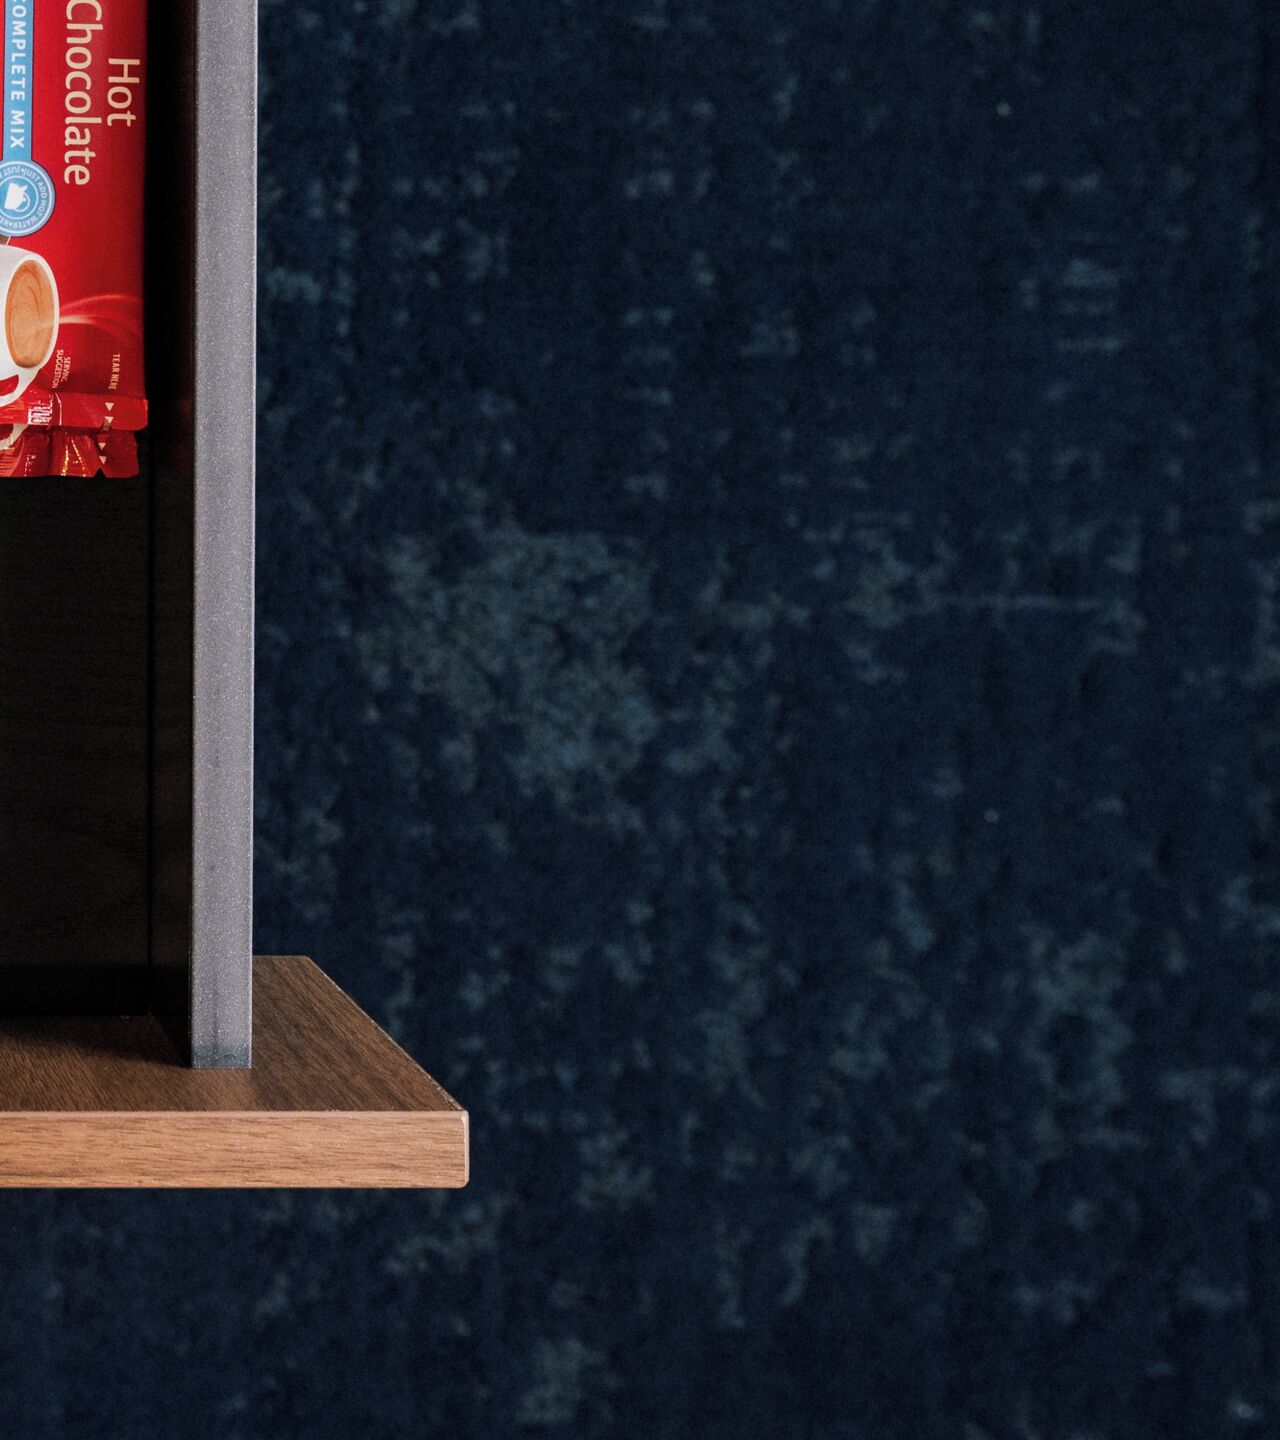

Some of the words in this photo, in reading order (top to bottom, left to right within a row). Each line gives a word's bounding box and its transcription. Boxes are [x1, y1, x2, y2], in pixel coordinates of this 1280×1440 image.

[107, 58, 140, 127] Hot
[10, 110, 26, 149] MIX
[37, 182, 48, 199] ADD
[36, 200, 47, 217] HOT
[111, 353, 121, 373] TEAR
[108, 374, 120, 390] HERE
